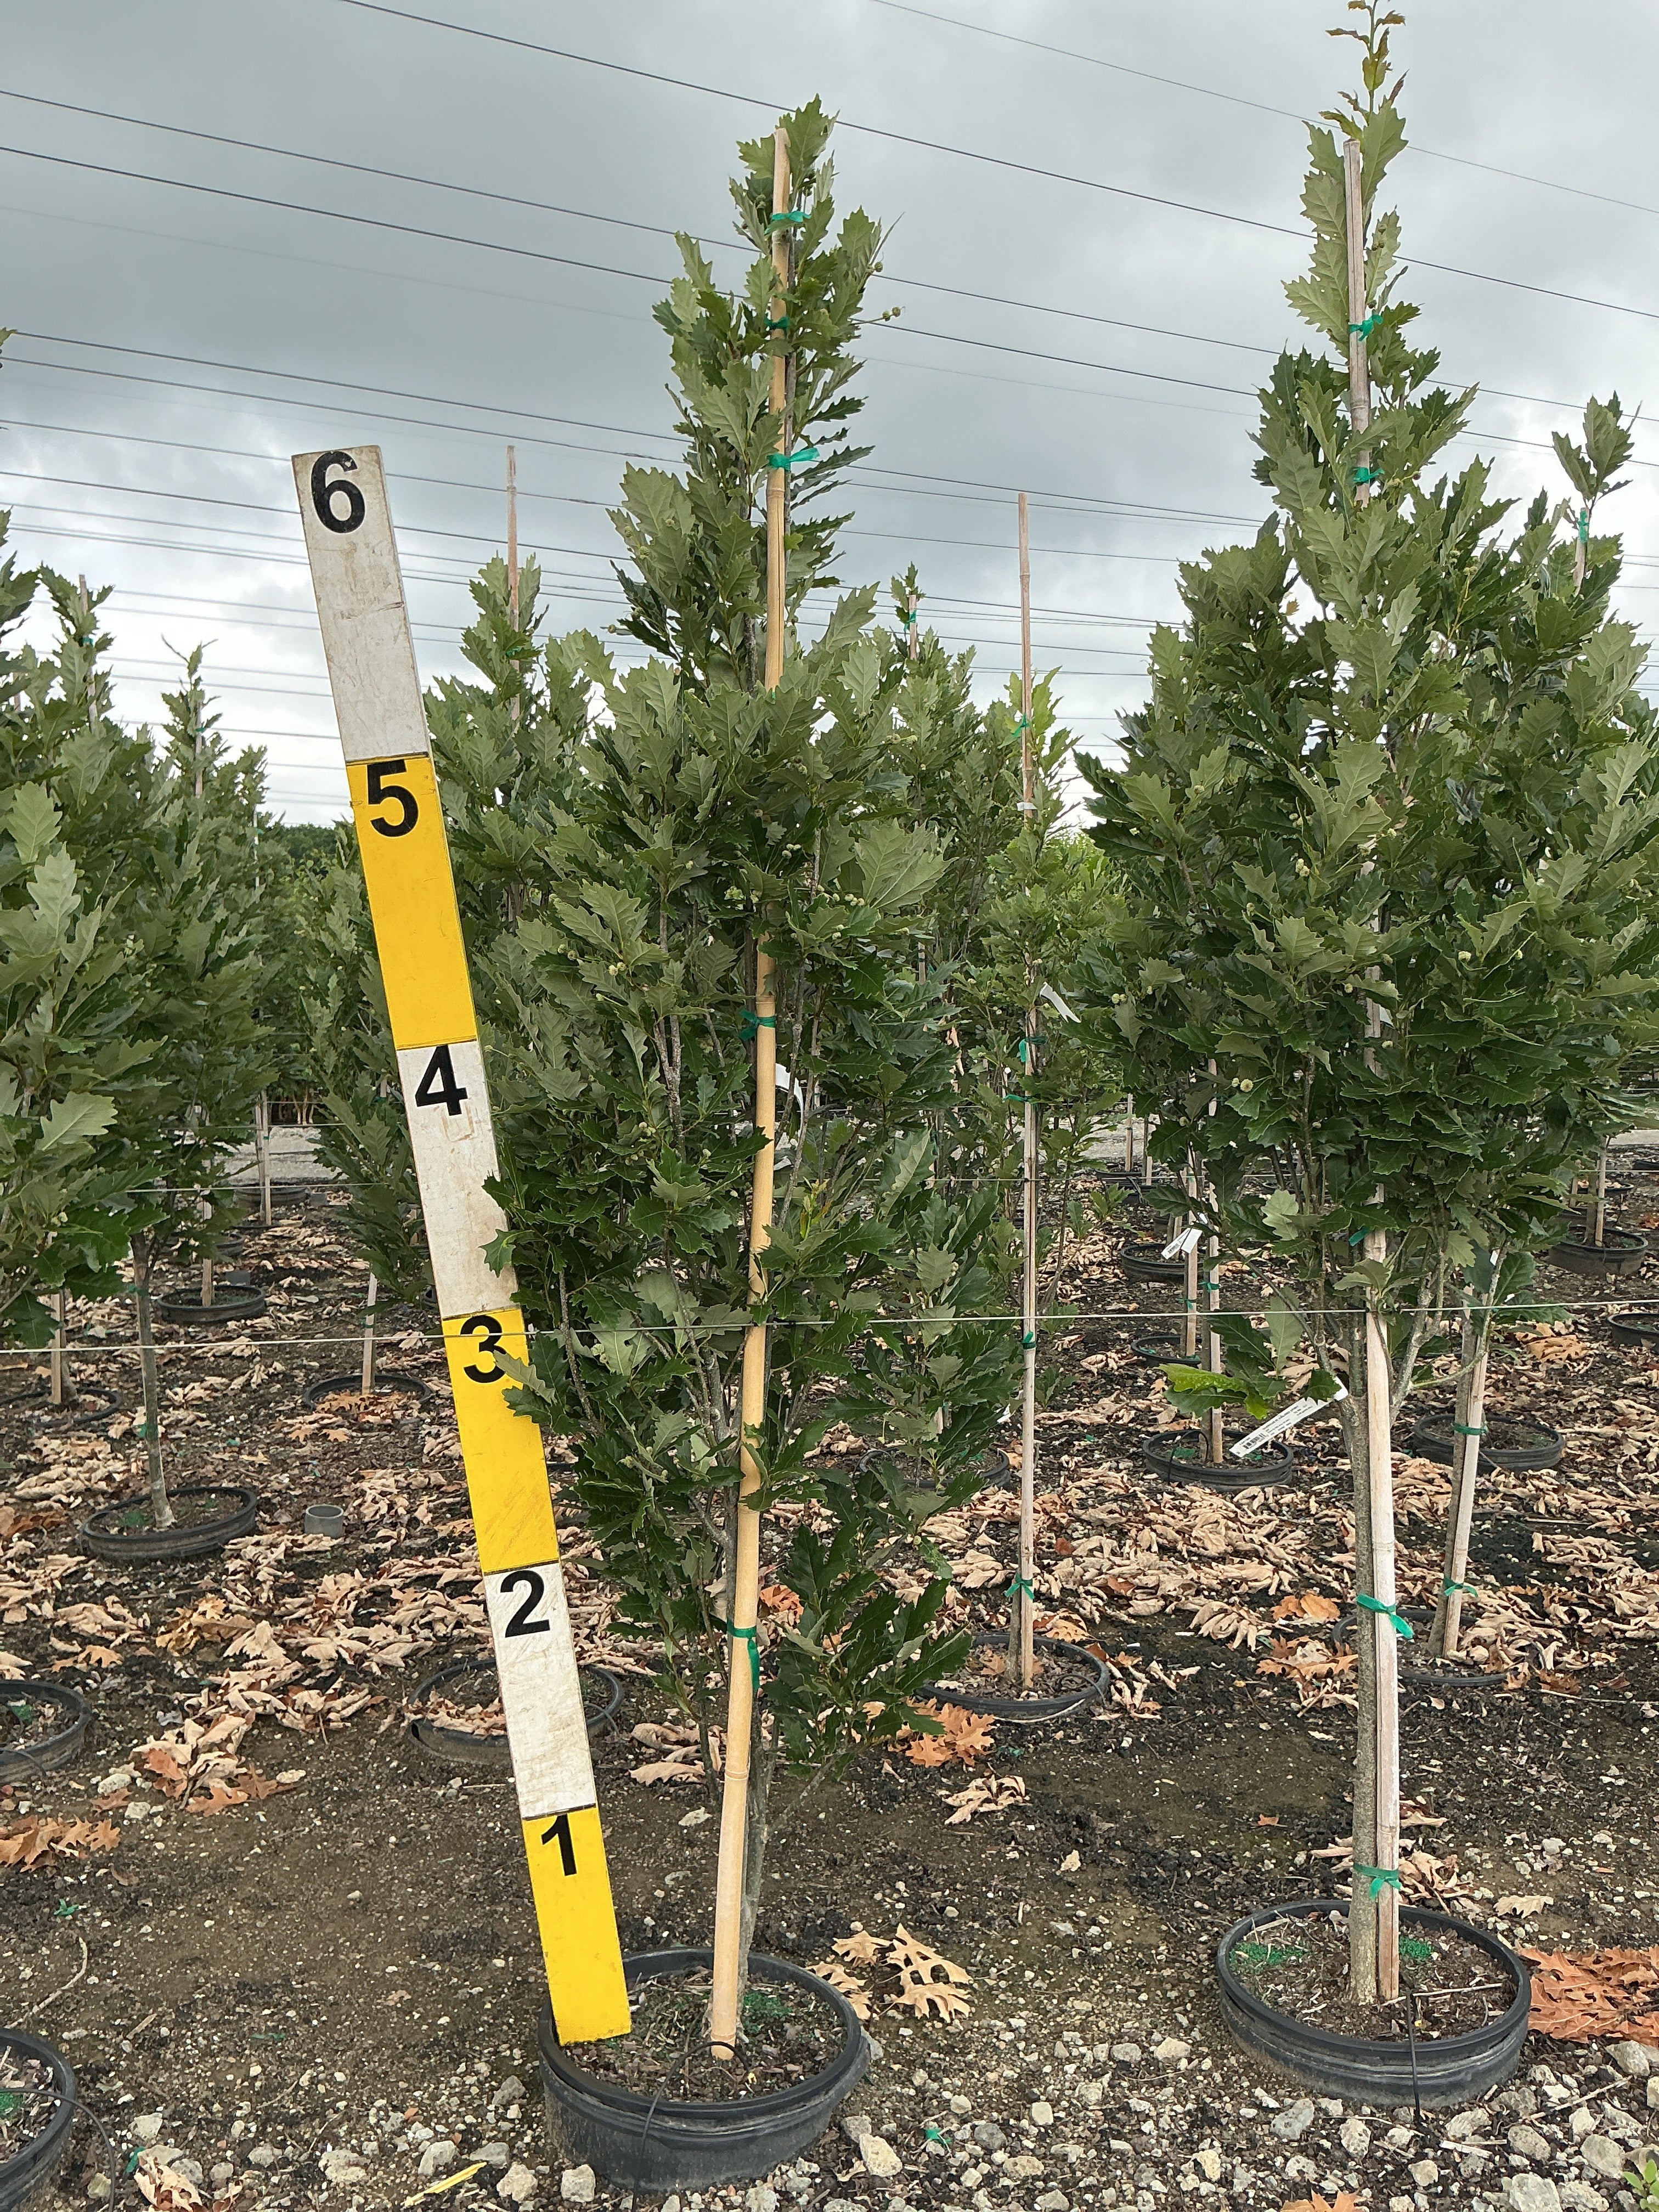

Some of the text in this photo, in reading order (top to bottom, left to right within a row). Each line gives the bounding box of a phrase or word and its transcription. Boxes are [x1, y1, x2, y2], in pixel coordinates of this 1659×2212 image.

[311, 450, 365, 533] 6
[367, 759, 418, 837] 5
[415, 1045, 468, 1116] 4
[460, 1314, 507, 1383] 3
[500, 1570, 550, 1638] 2
[541, 1814, 577, 1876] 1
